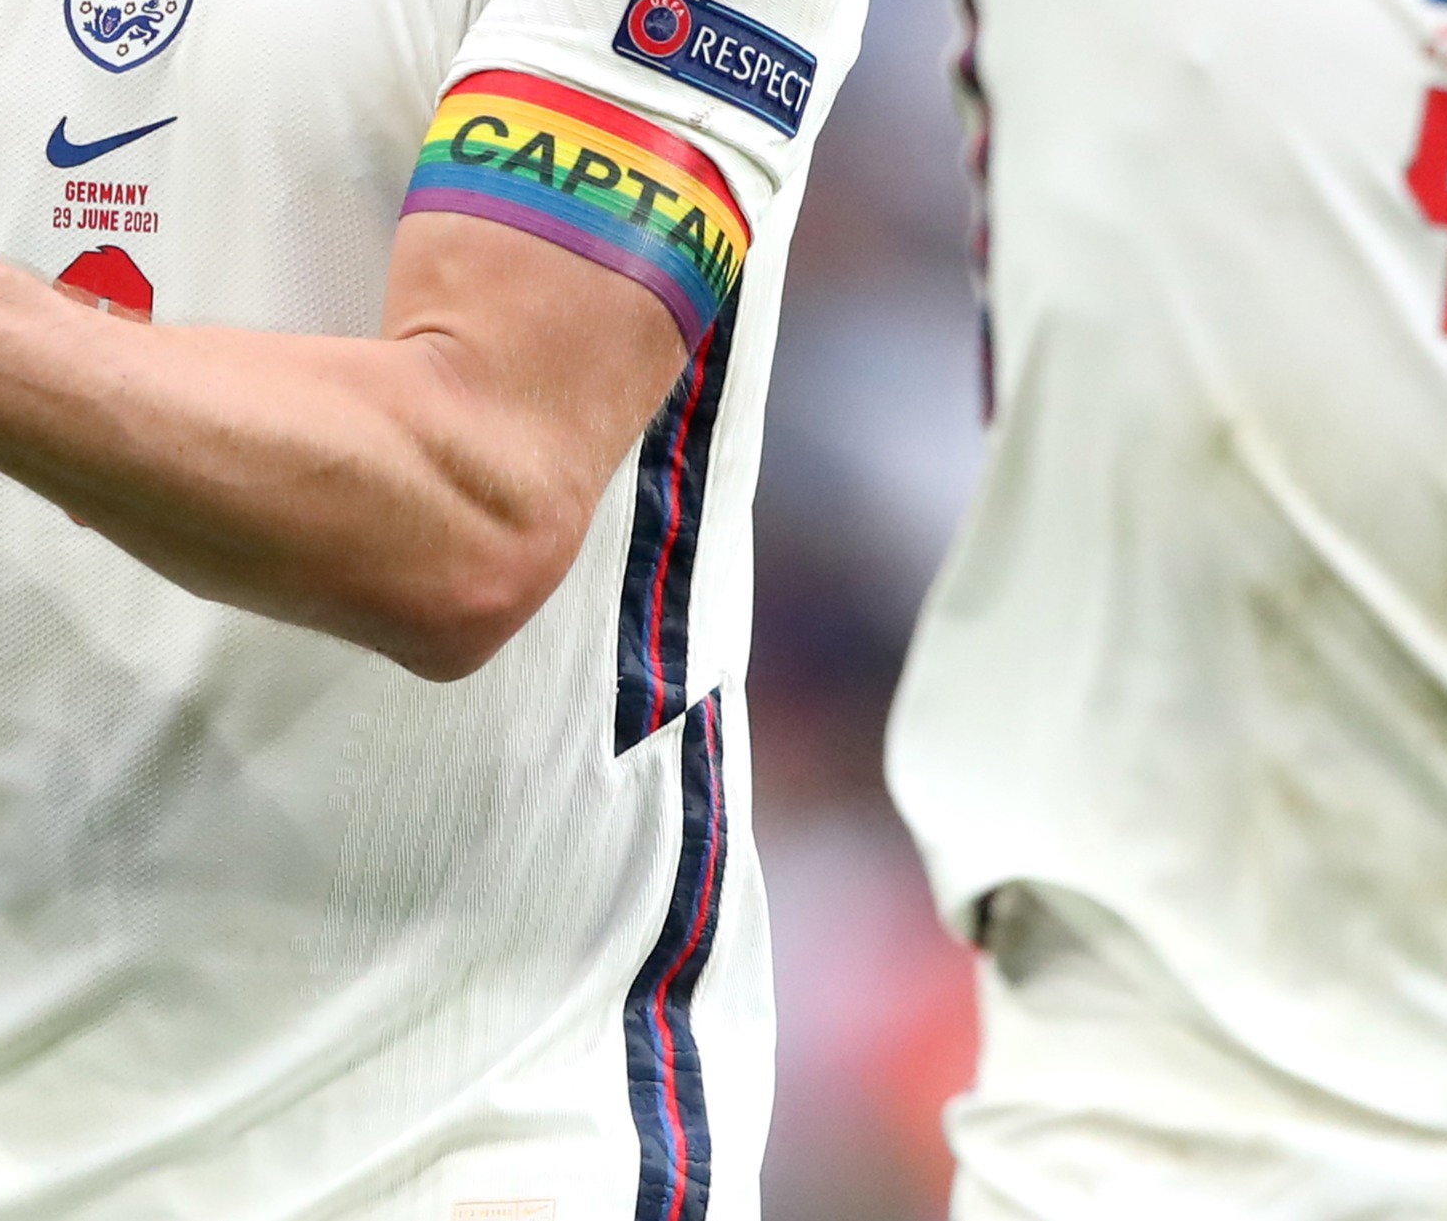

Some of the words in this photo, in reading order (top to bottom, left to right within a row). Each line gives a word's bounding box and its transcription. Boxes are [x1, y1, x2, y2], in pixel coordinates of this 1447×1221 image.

[690, 25, 811, 112] RESPECT
[53, 206, 72, 229] 29
[77, 208, 120, 232] JUNE
[124, 210, 158, 234] 2021
[64, 180, 149, 206] GERMANY
[450, 115, 740, 303] CAPTAIN
